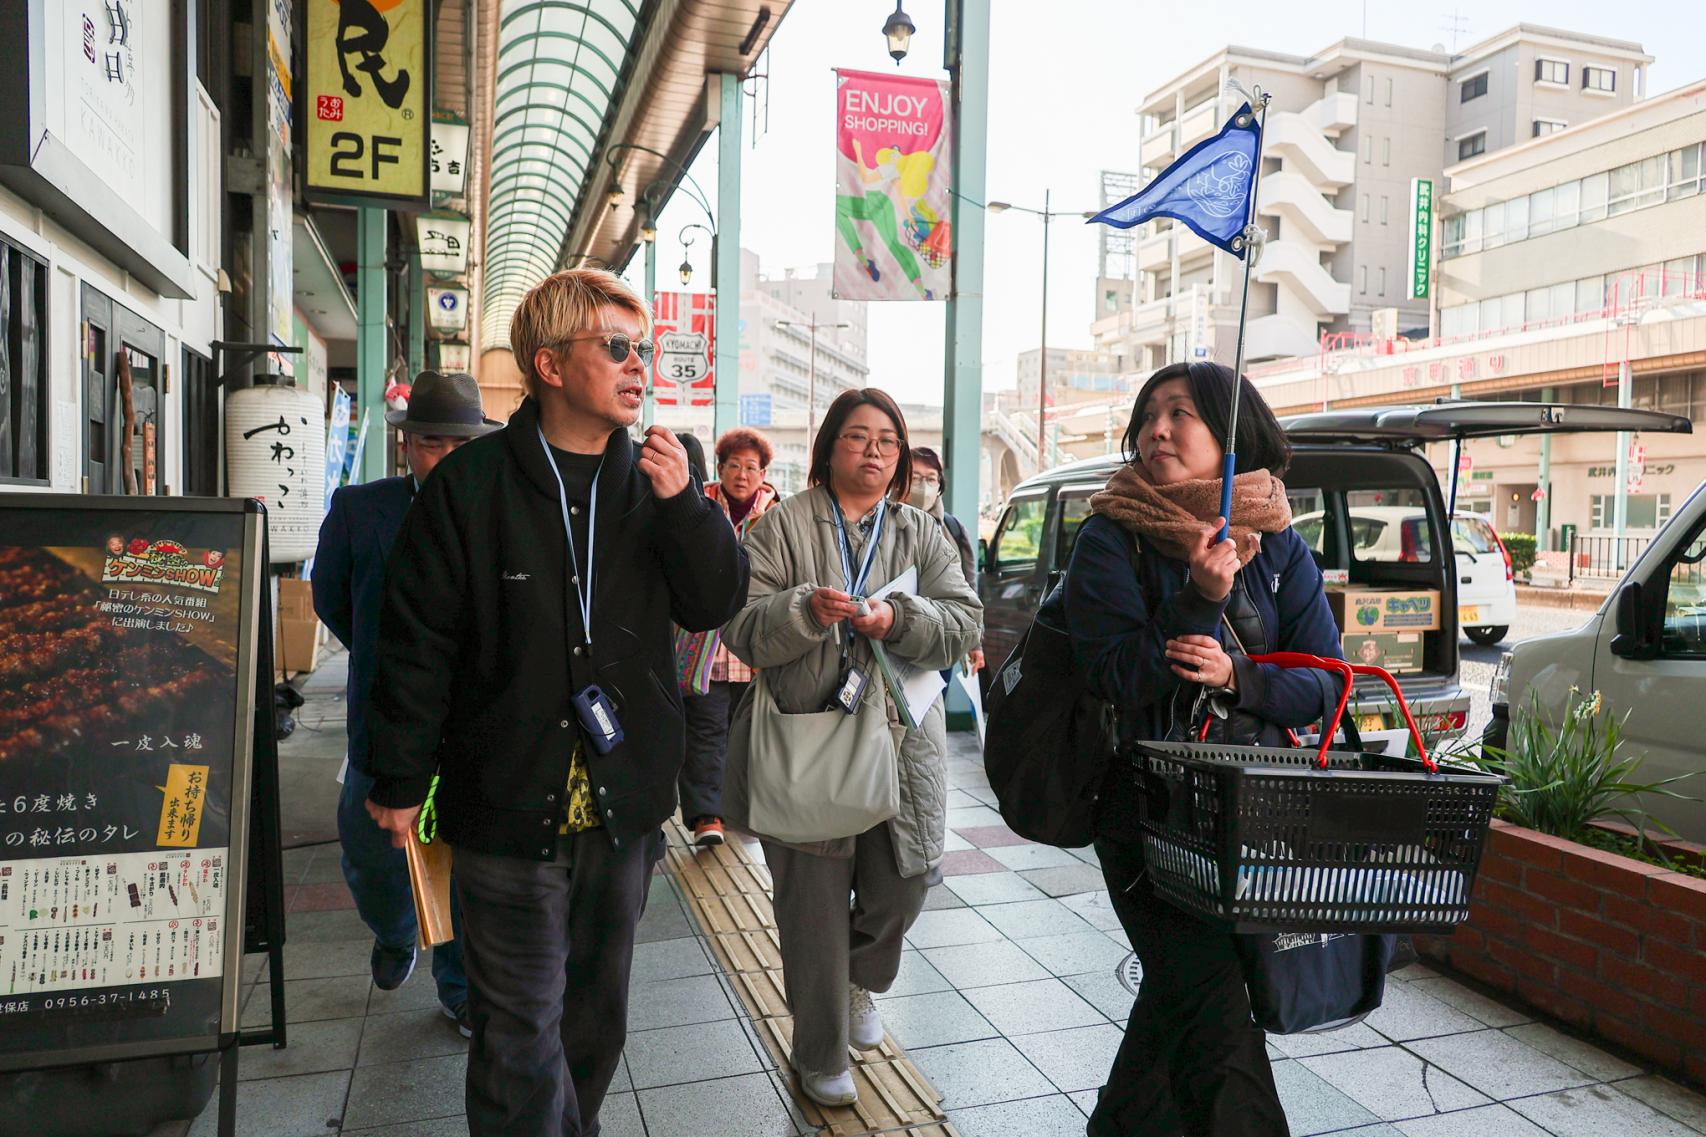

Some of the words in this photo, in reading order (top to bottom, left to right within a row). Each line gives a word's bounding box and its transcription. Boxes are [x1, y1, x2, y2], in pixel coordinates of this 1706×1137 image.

[845, 89, 928, 118] ENJOY
[844, 114, 929, 137] SHOPPING!
[330, 131, 402, 180] 2F
[1417, 183, 1429, 296] 武井内科クリニック
[671, 364, 697, 378] 35
[107, 558, 218, 588] ケンミンSHOW
[108, 588, 207, 608] 日テレ系の人気番組
[111, 734, 203, 750] 一皮入魂
[179, 771, 202, 842] お持ち帰り
[5, 824, 140, 847] の秘伝のタレ
[44, 988, 170, 1010] 0956-37-1485
